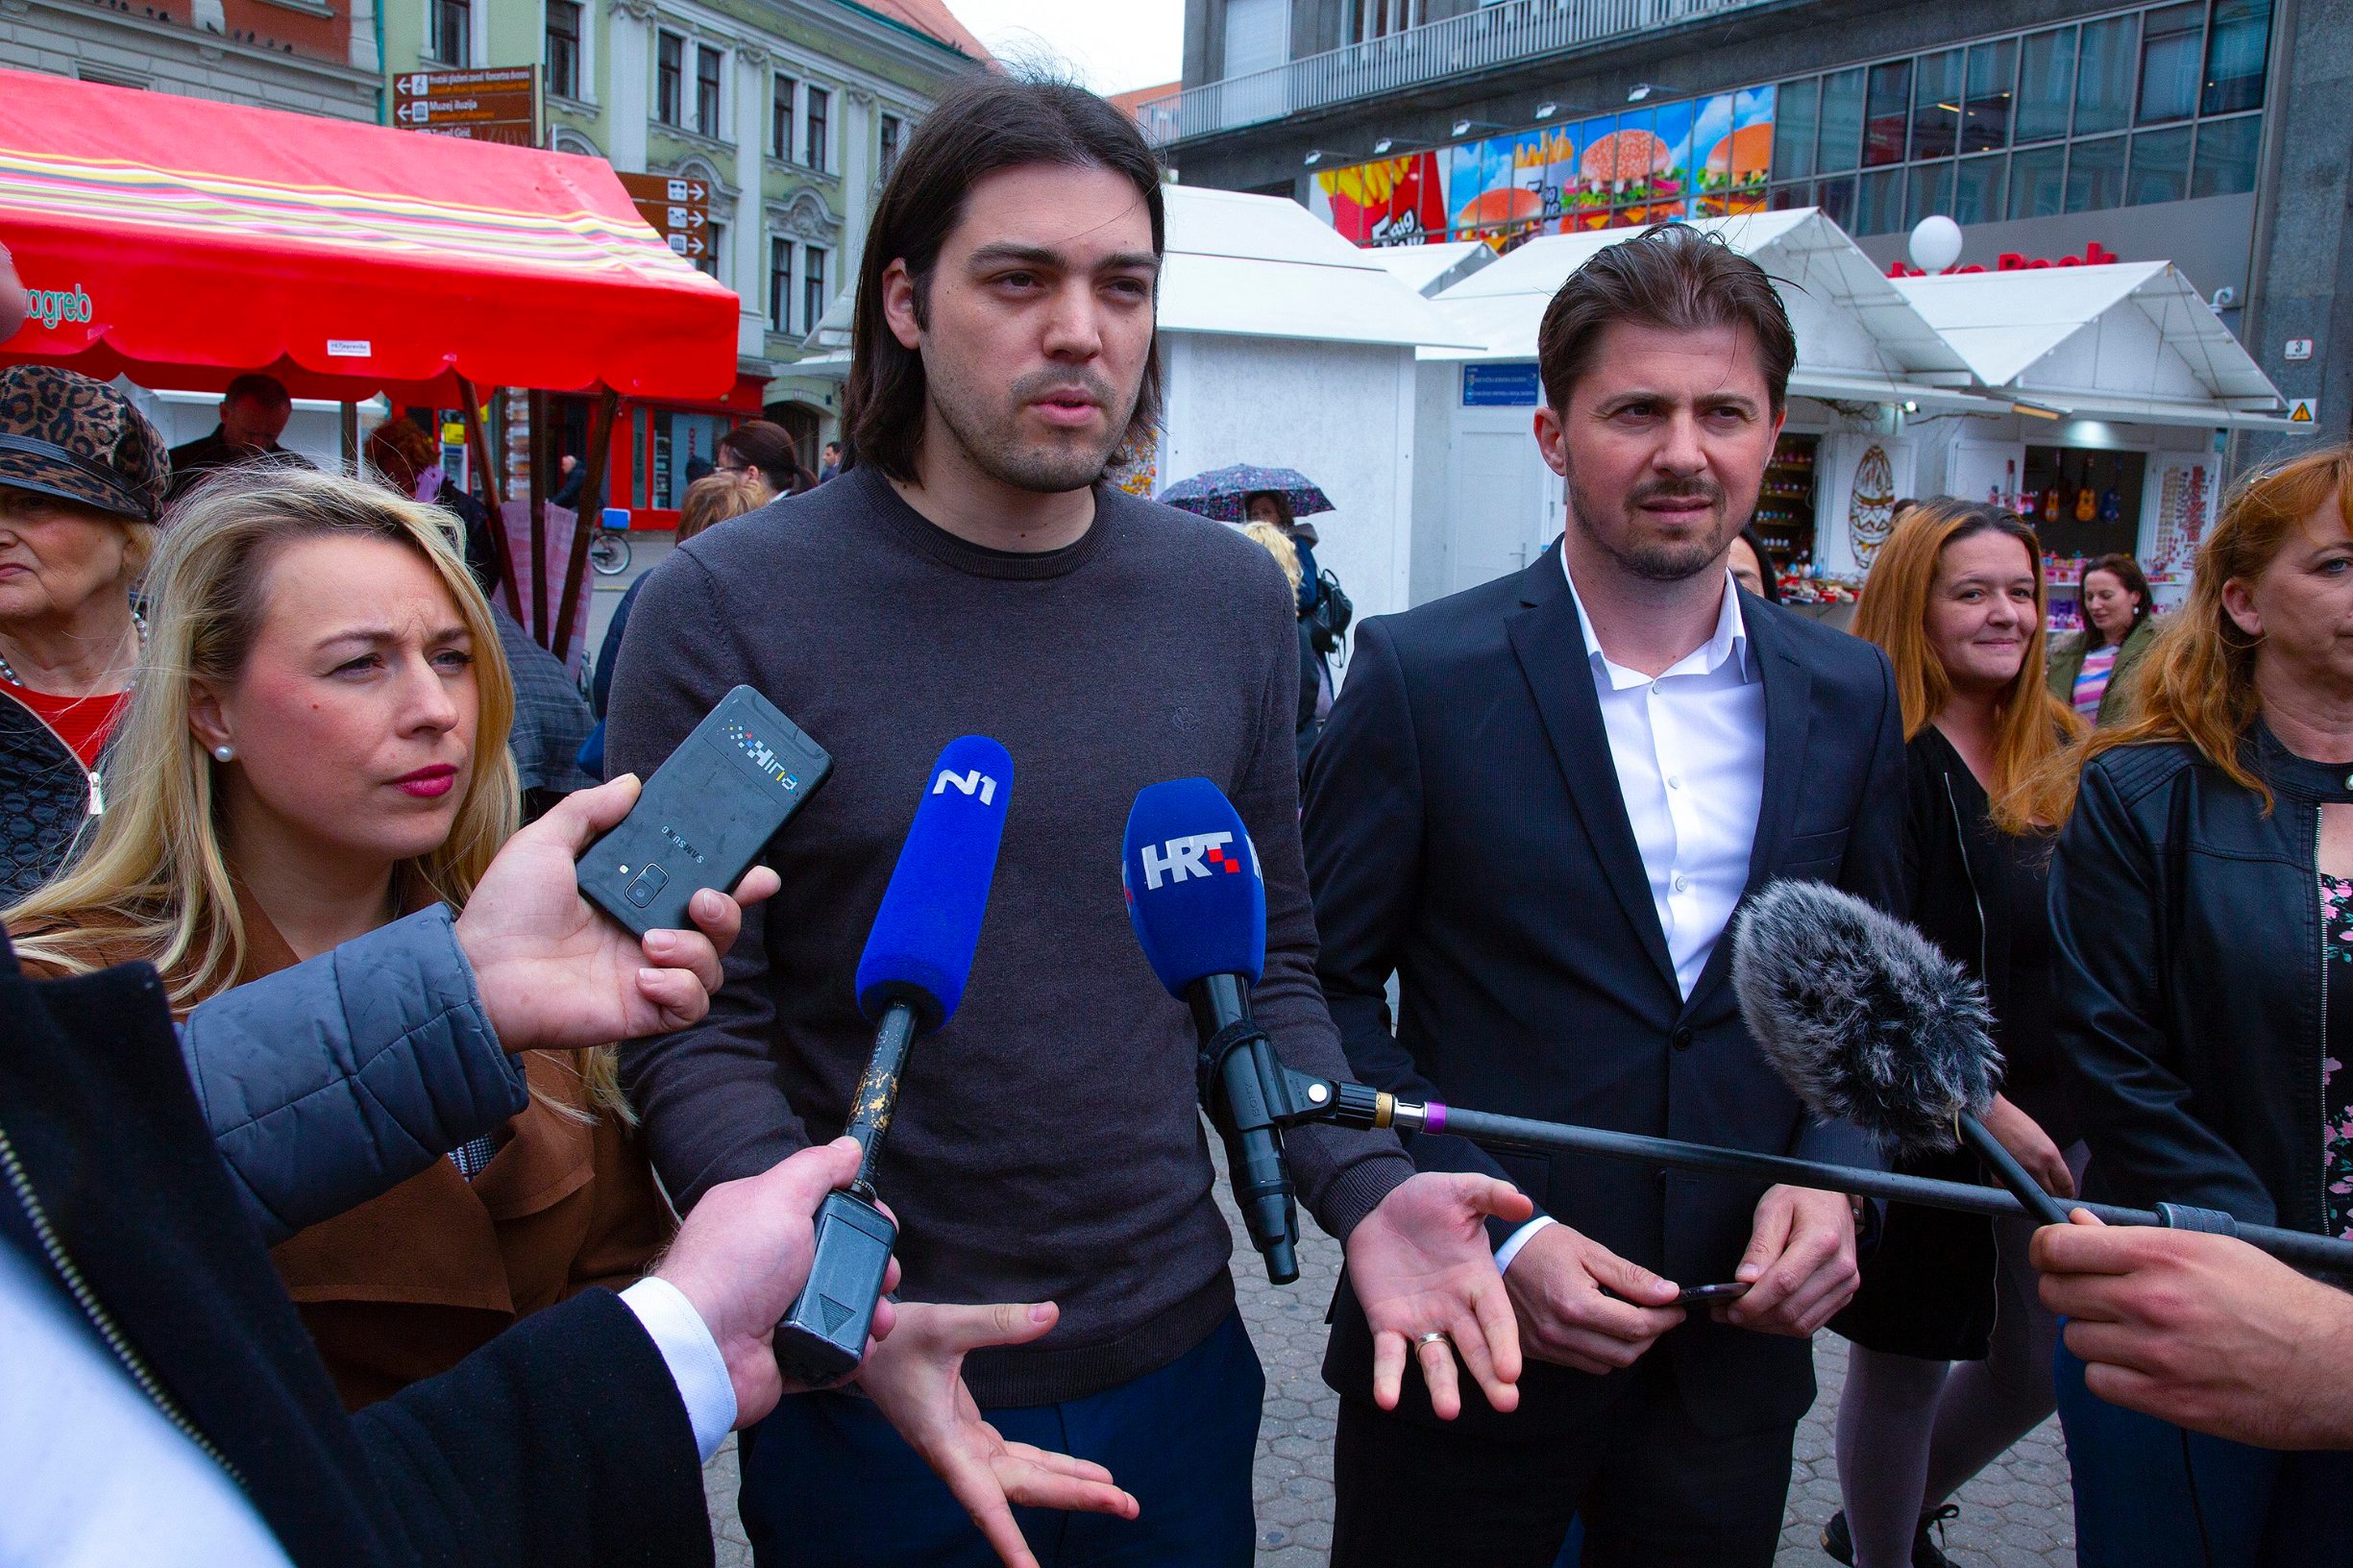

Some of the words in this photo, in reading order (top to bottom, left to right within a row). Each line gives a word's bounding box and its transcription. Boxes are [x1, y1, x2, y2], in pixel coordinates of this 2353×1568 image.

[429, 101, 453, 111] Muzej
[2295, 341, 2303, 353] 3
[932, 769, 997, 806] N1
[661, 825, 704, 864] SAMSUNG
[1141, 831, 1239, 891] HRT
